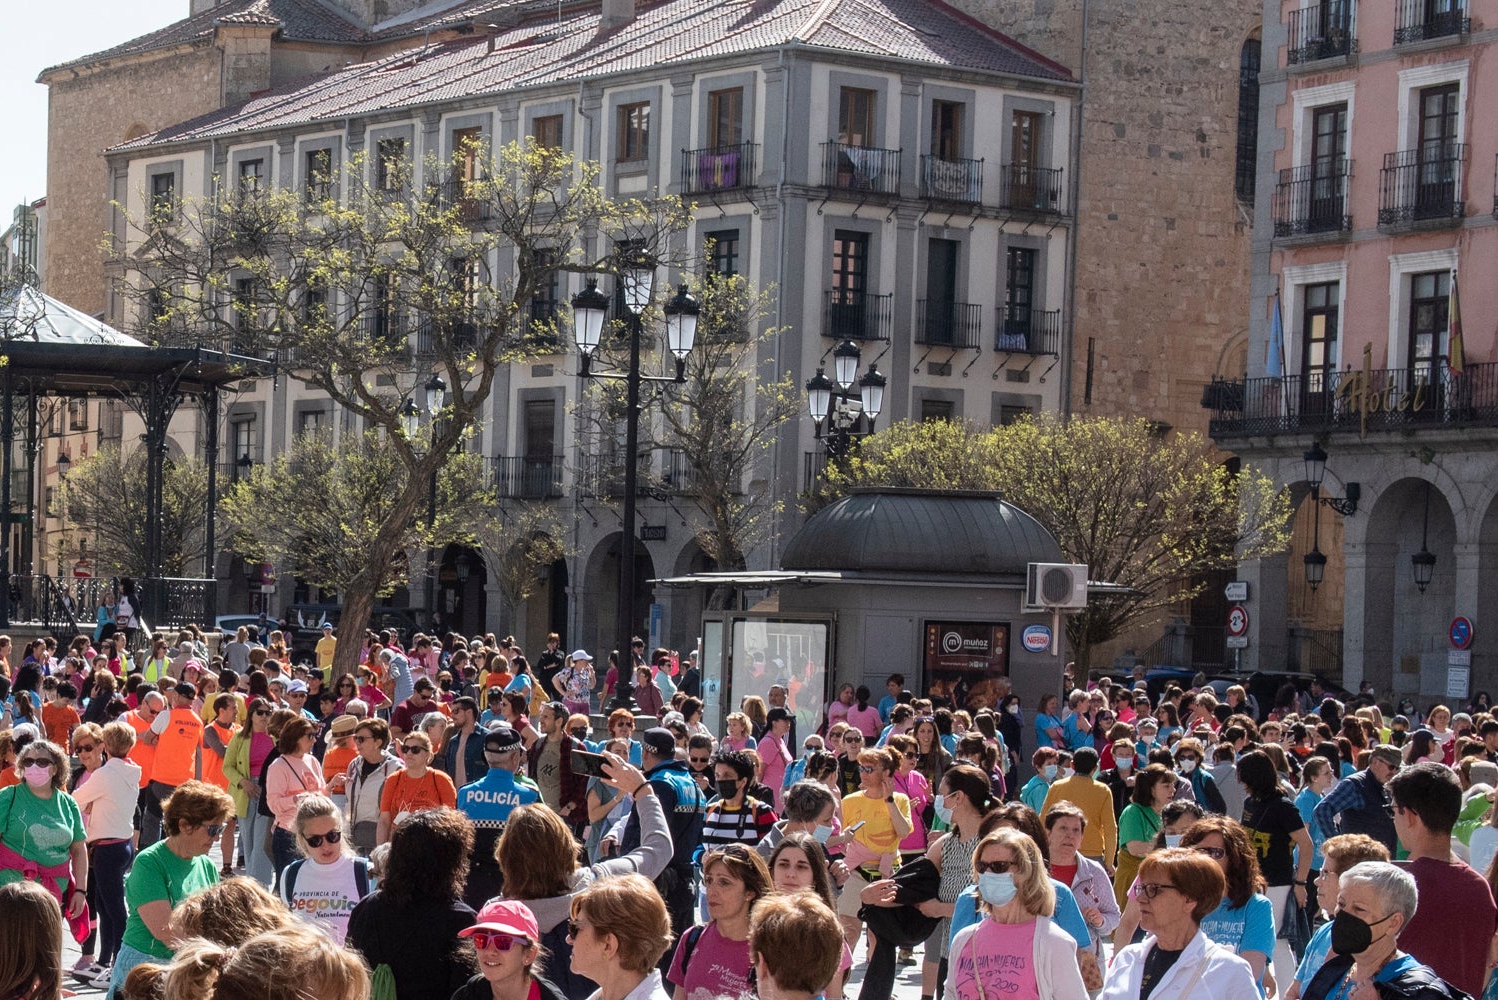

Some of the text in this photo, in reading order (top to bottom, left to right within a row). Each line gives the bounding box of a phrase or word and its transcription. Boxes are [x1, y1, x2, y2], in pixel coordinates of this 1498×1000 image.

[1336, 341, 1428, 439] Hotel
[466, 790, 521, 807] POLICÍA
[993, 954, 1026, 970] MUJERES
